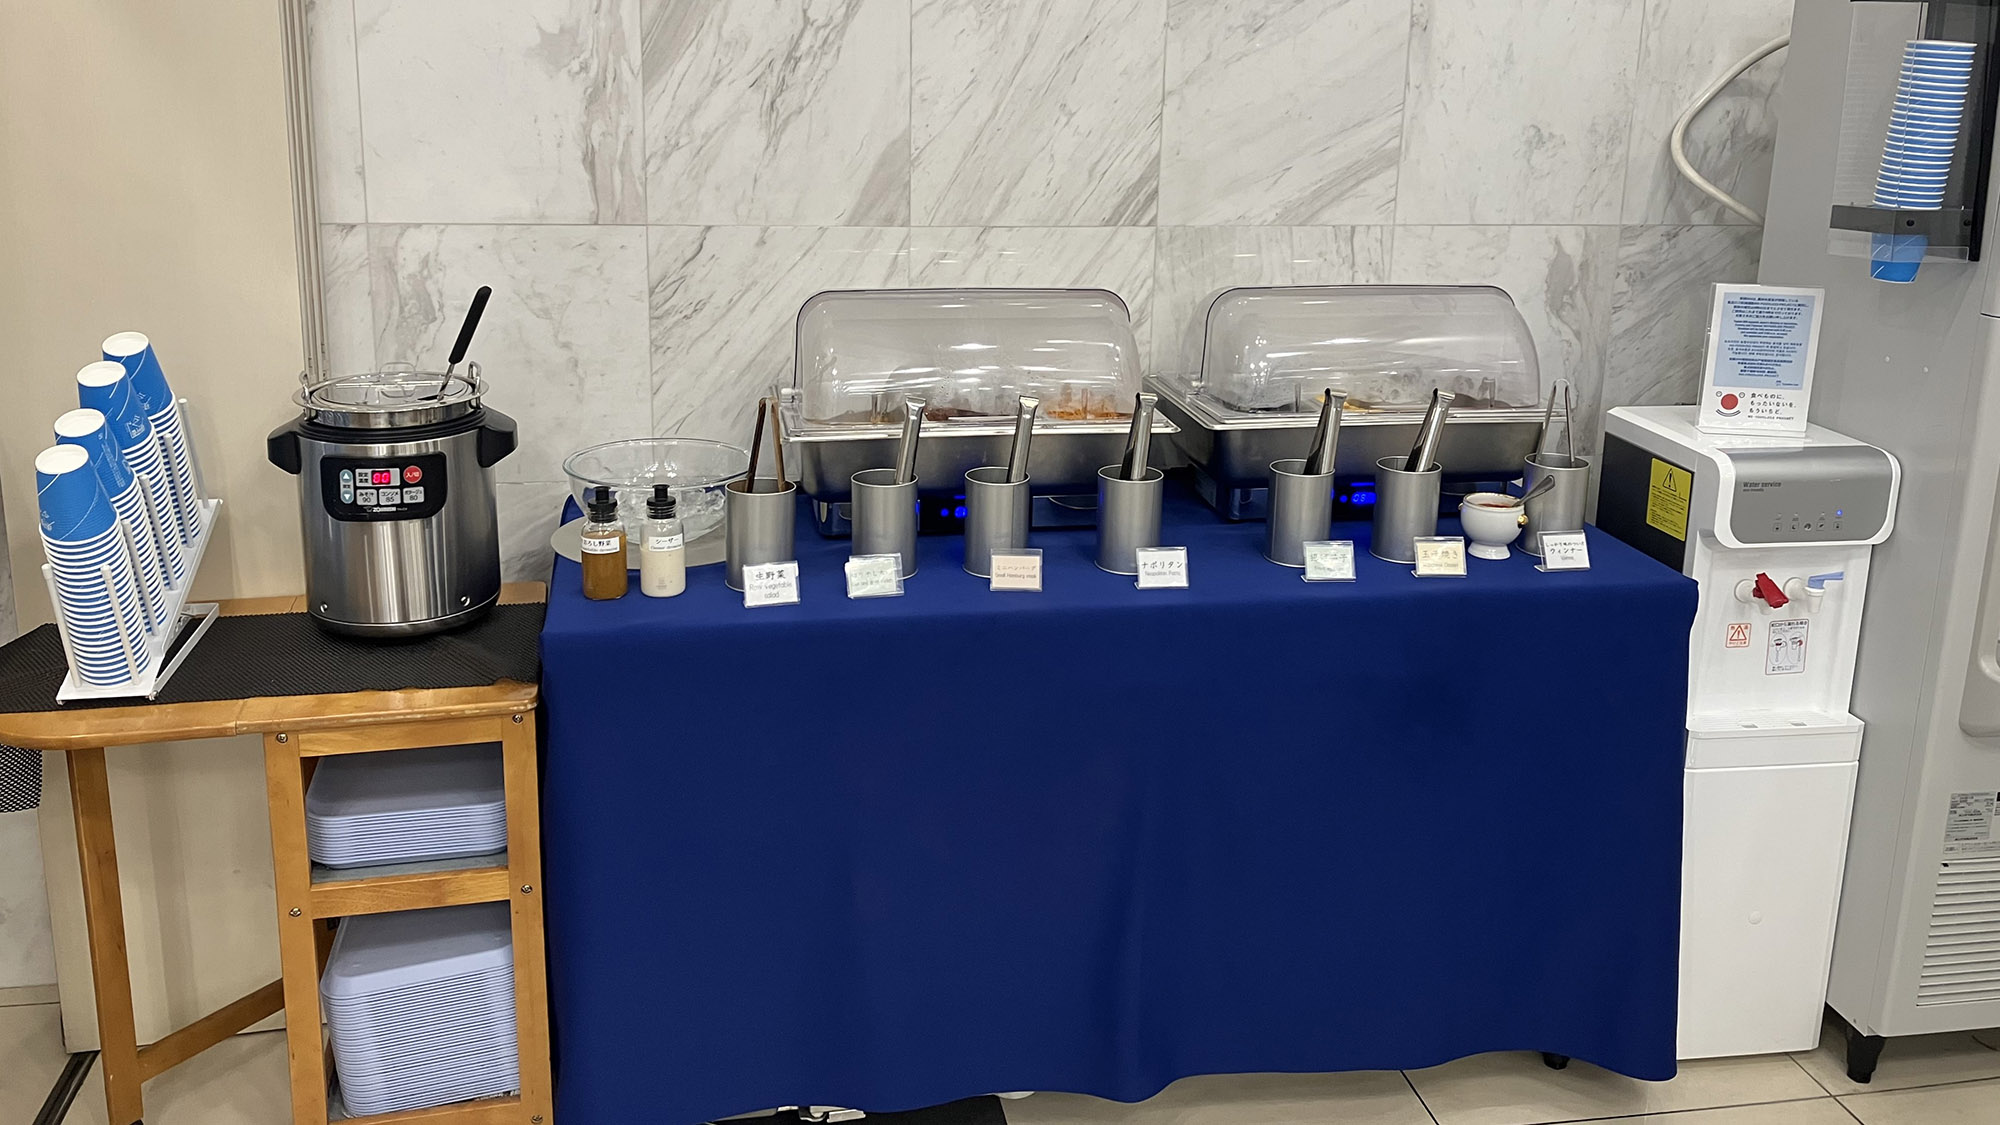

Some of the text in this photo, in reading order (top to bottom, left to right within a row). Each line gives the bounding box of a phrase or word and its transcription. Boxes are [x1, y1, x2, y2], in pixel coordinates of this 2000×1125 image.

[1141, 561, 1183, 569] ナポリタン
[755, 569, 786, 581] 生野菜
